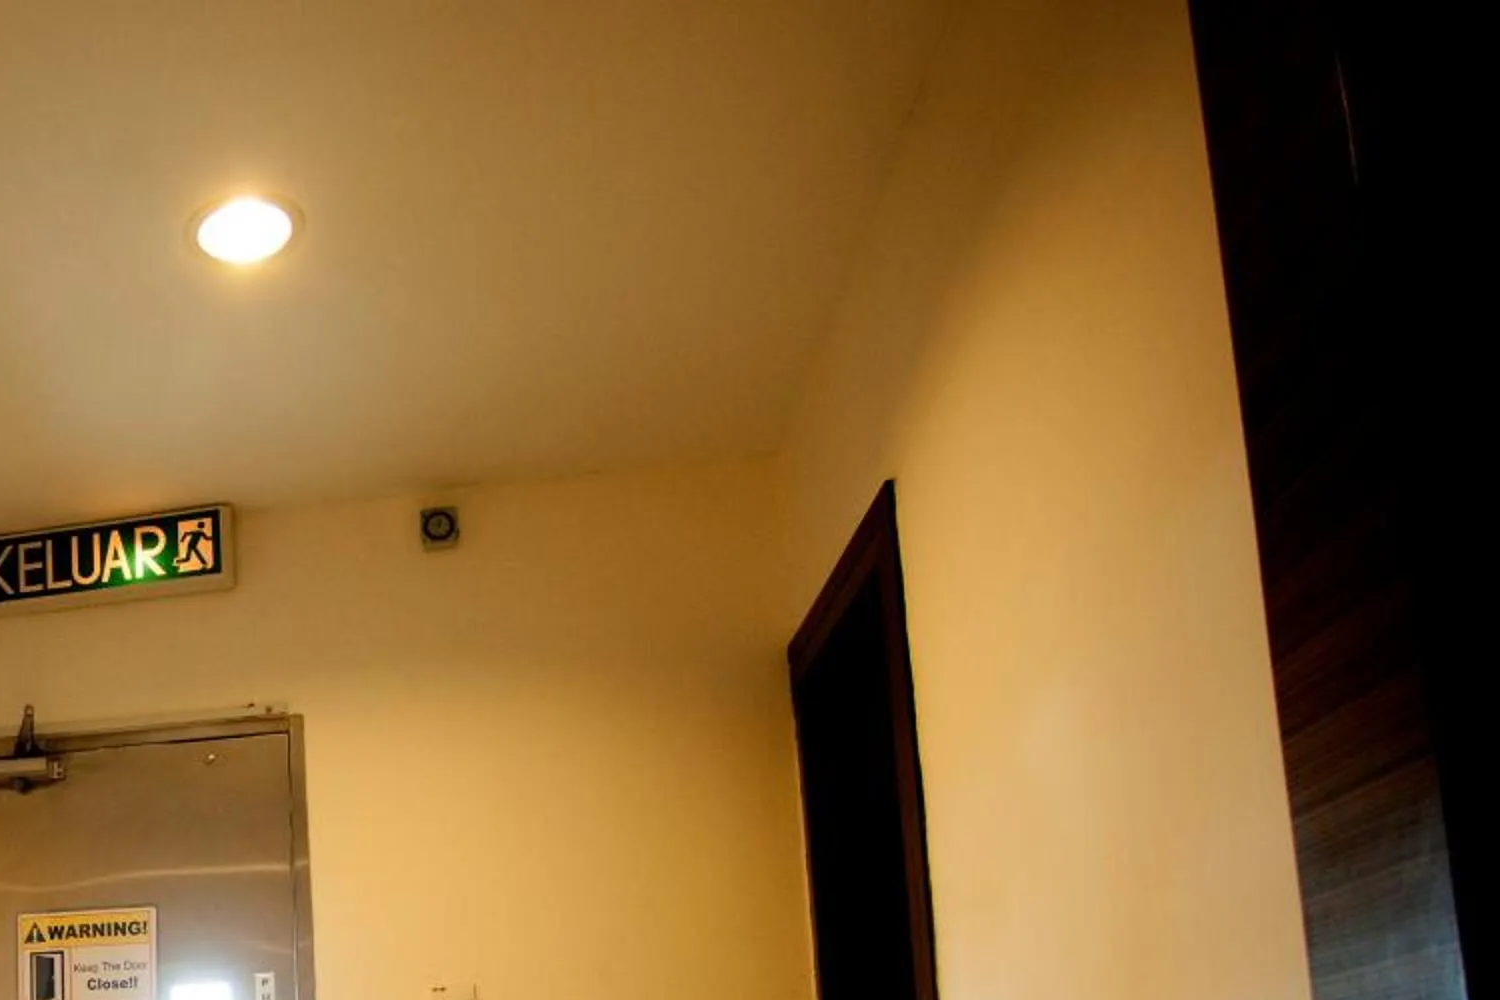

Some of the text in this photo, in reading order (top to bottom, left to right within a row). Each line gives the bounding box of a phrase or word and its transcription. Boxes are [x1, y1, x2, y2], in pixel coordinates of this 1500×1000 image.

[47, 920, 148, 941] WARNING!
[102, 961, 121, 971] The
[123, 960, 148, 971] Door
